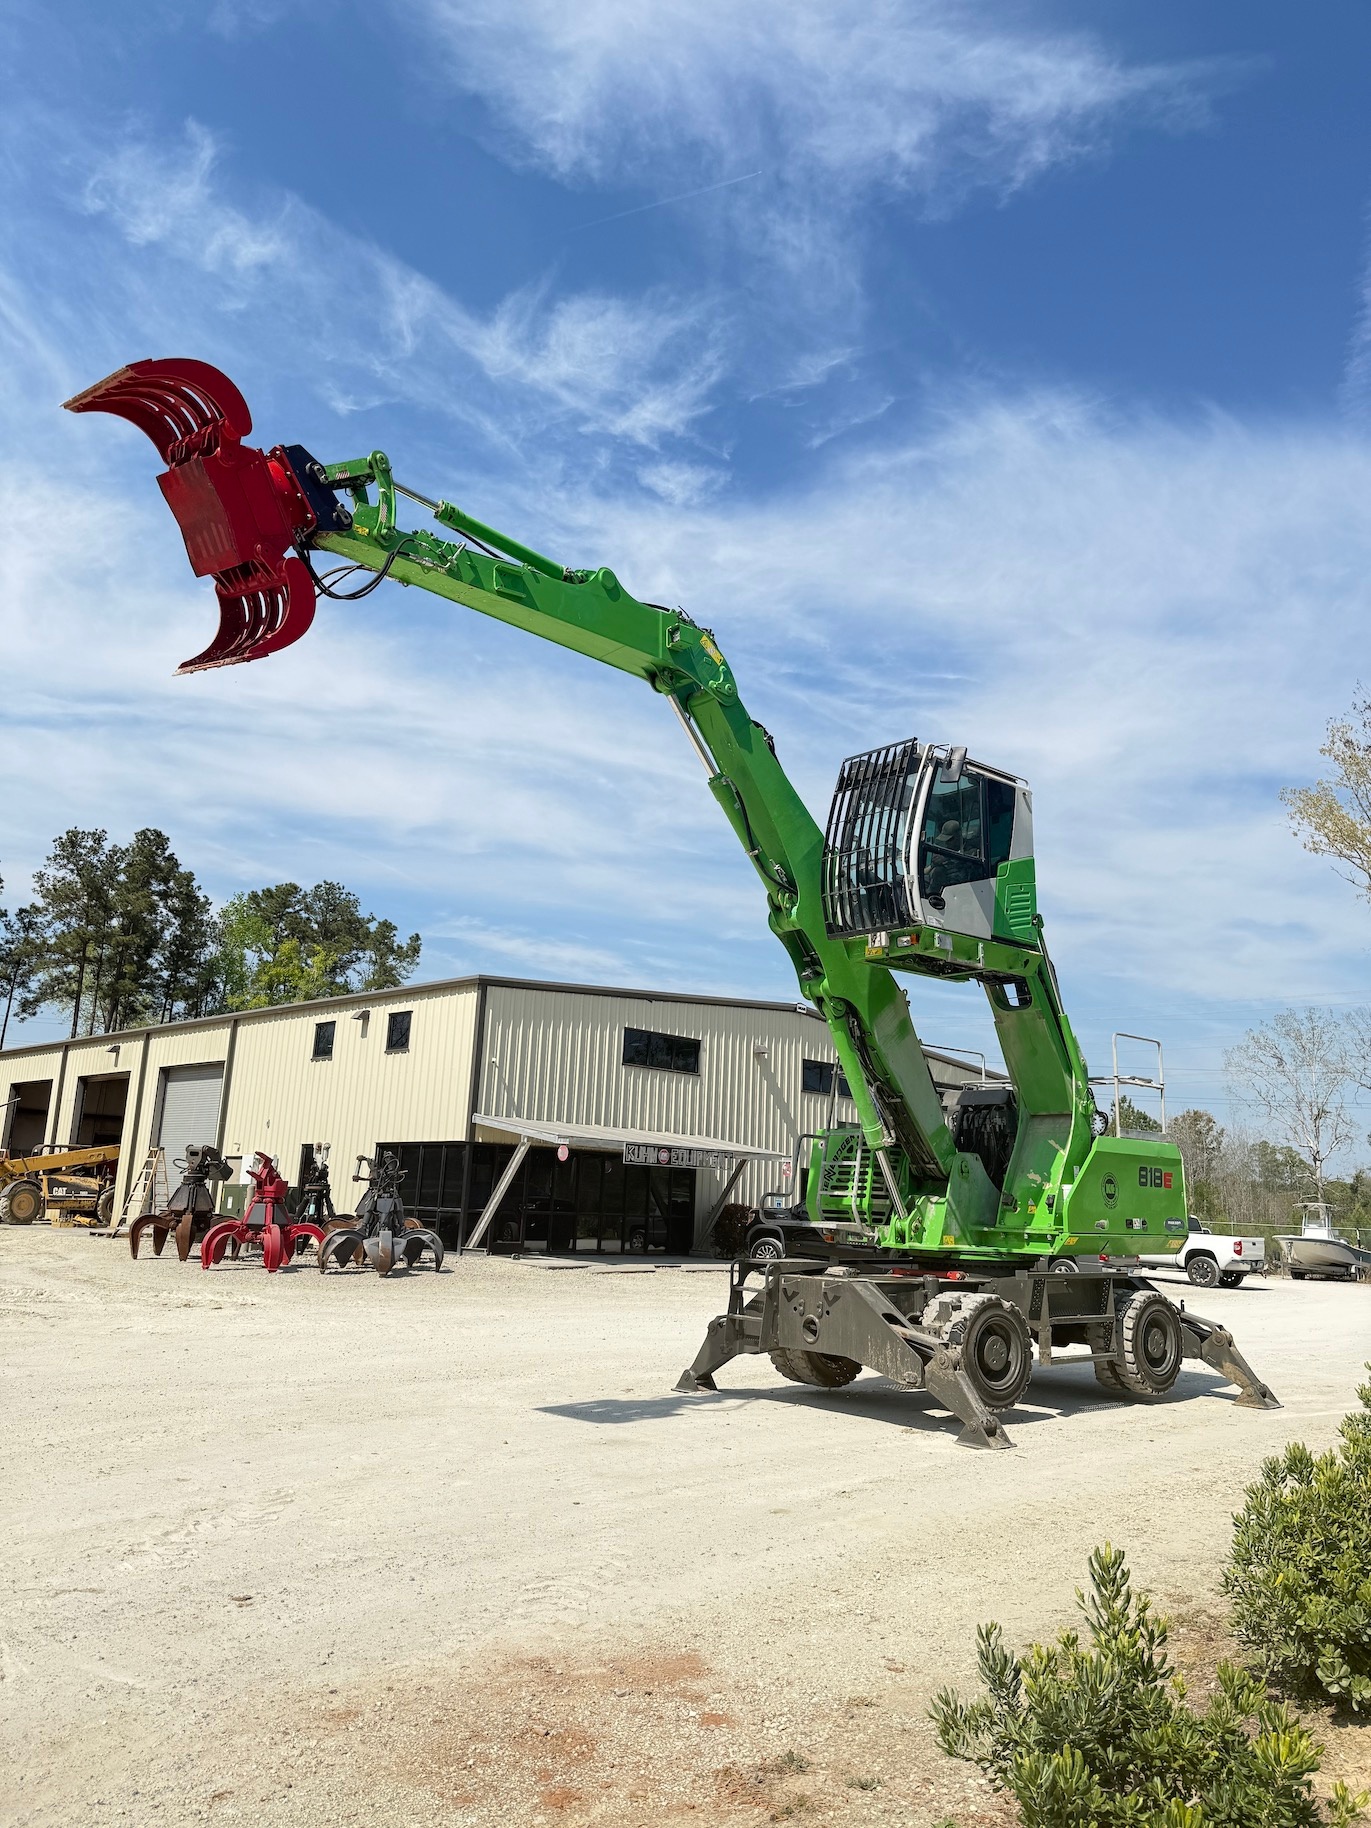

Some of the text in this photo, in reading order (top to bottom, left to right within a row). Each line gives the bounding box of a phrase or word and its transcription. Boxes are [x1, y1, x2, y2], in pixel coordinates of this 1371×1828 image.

[626, 1145, 658, 1164] KUHN
[1139, 1167, 1173, 1188] 818E
[53, 1187, 67, 1195] CAT
